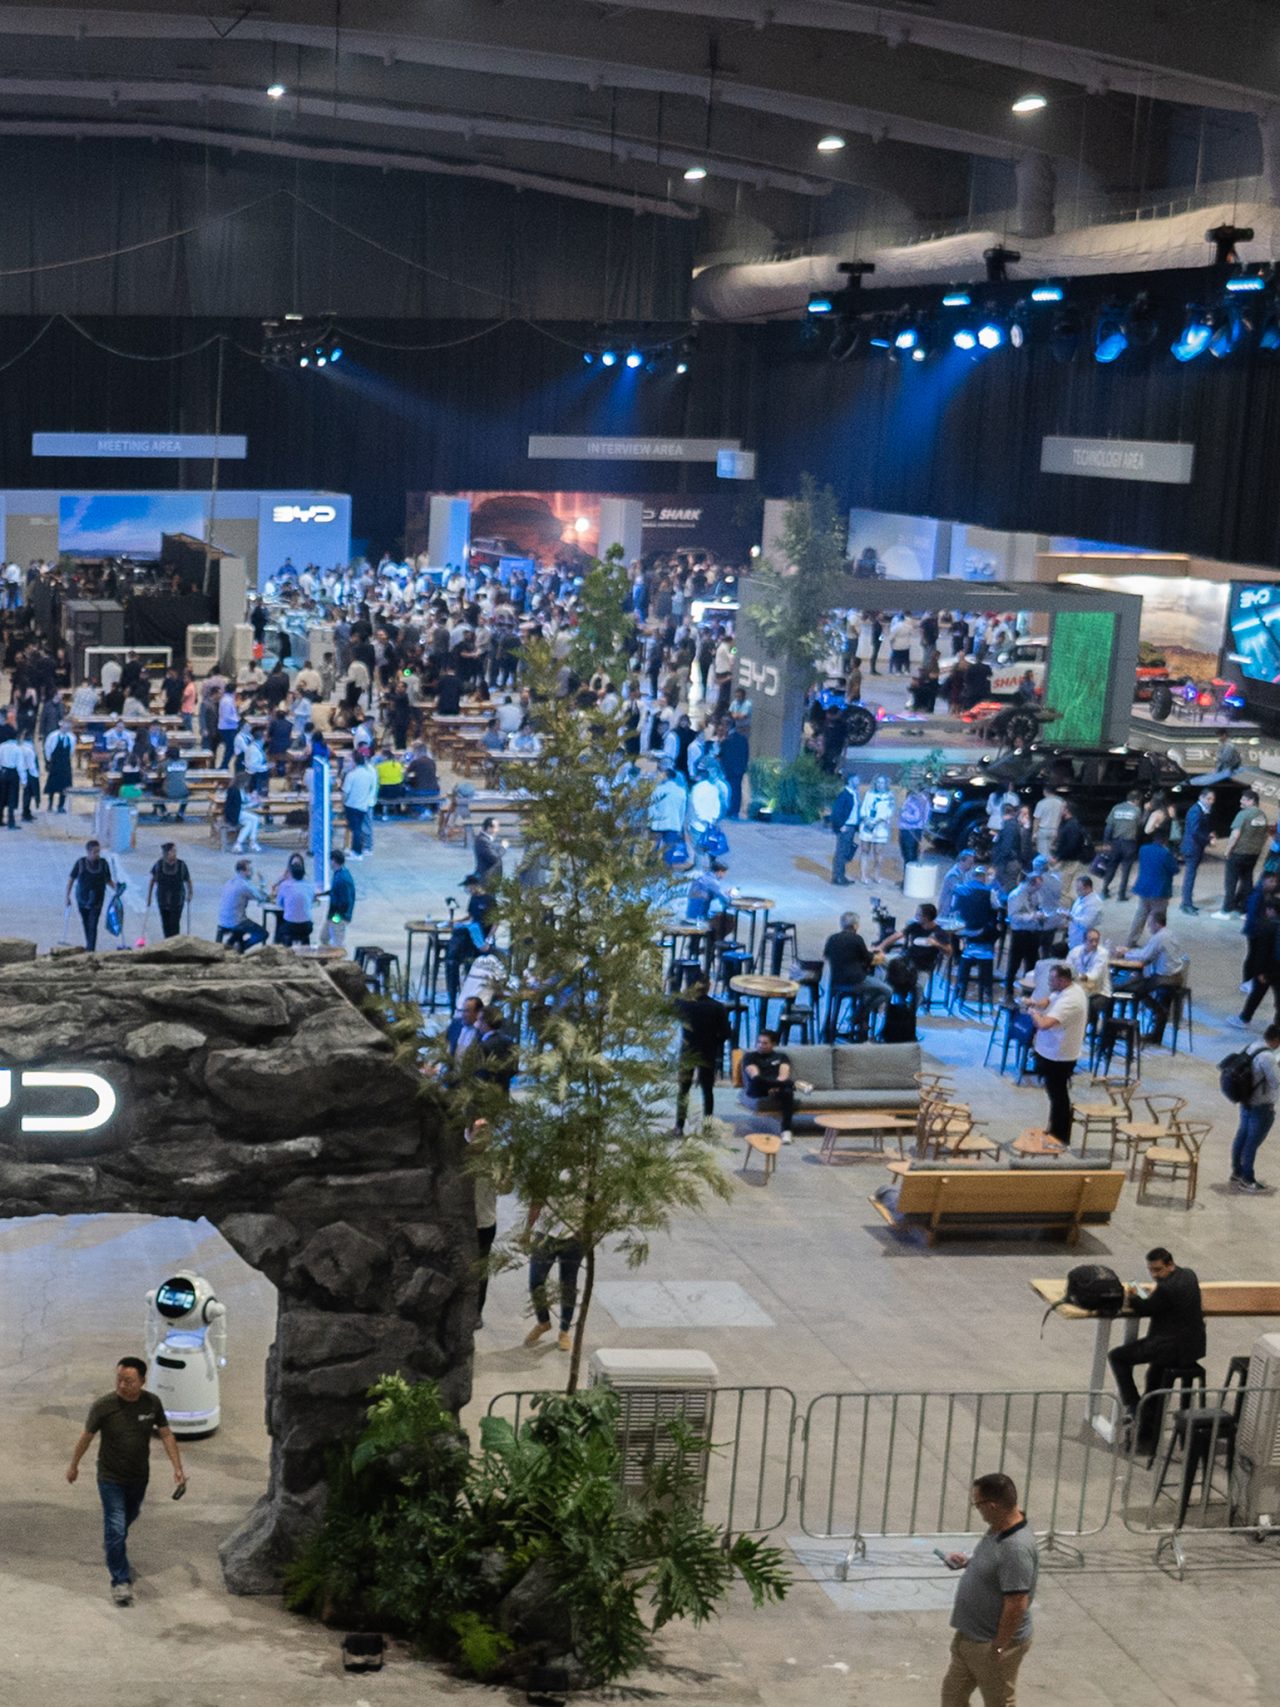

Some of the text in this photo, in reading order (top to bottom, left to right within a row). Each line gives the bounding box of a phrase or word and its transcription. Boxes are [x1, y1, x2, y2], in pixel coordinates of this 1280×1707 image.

[97, 440, 182, 452] MEETING AREA
[587, 443, 683, 455] INTERVIEW AREA
[273, 505, 336, 522] BYD
[659, 508, 702, 520] SHARK
[1240, 588, 1270, 608] BYD
[739, 658, 778, 697] BYD
